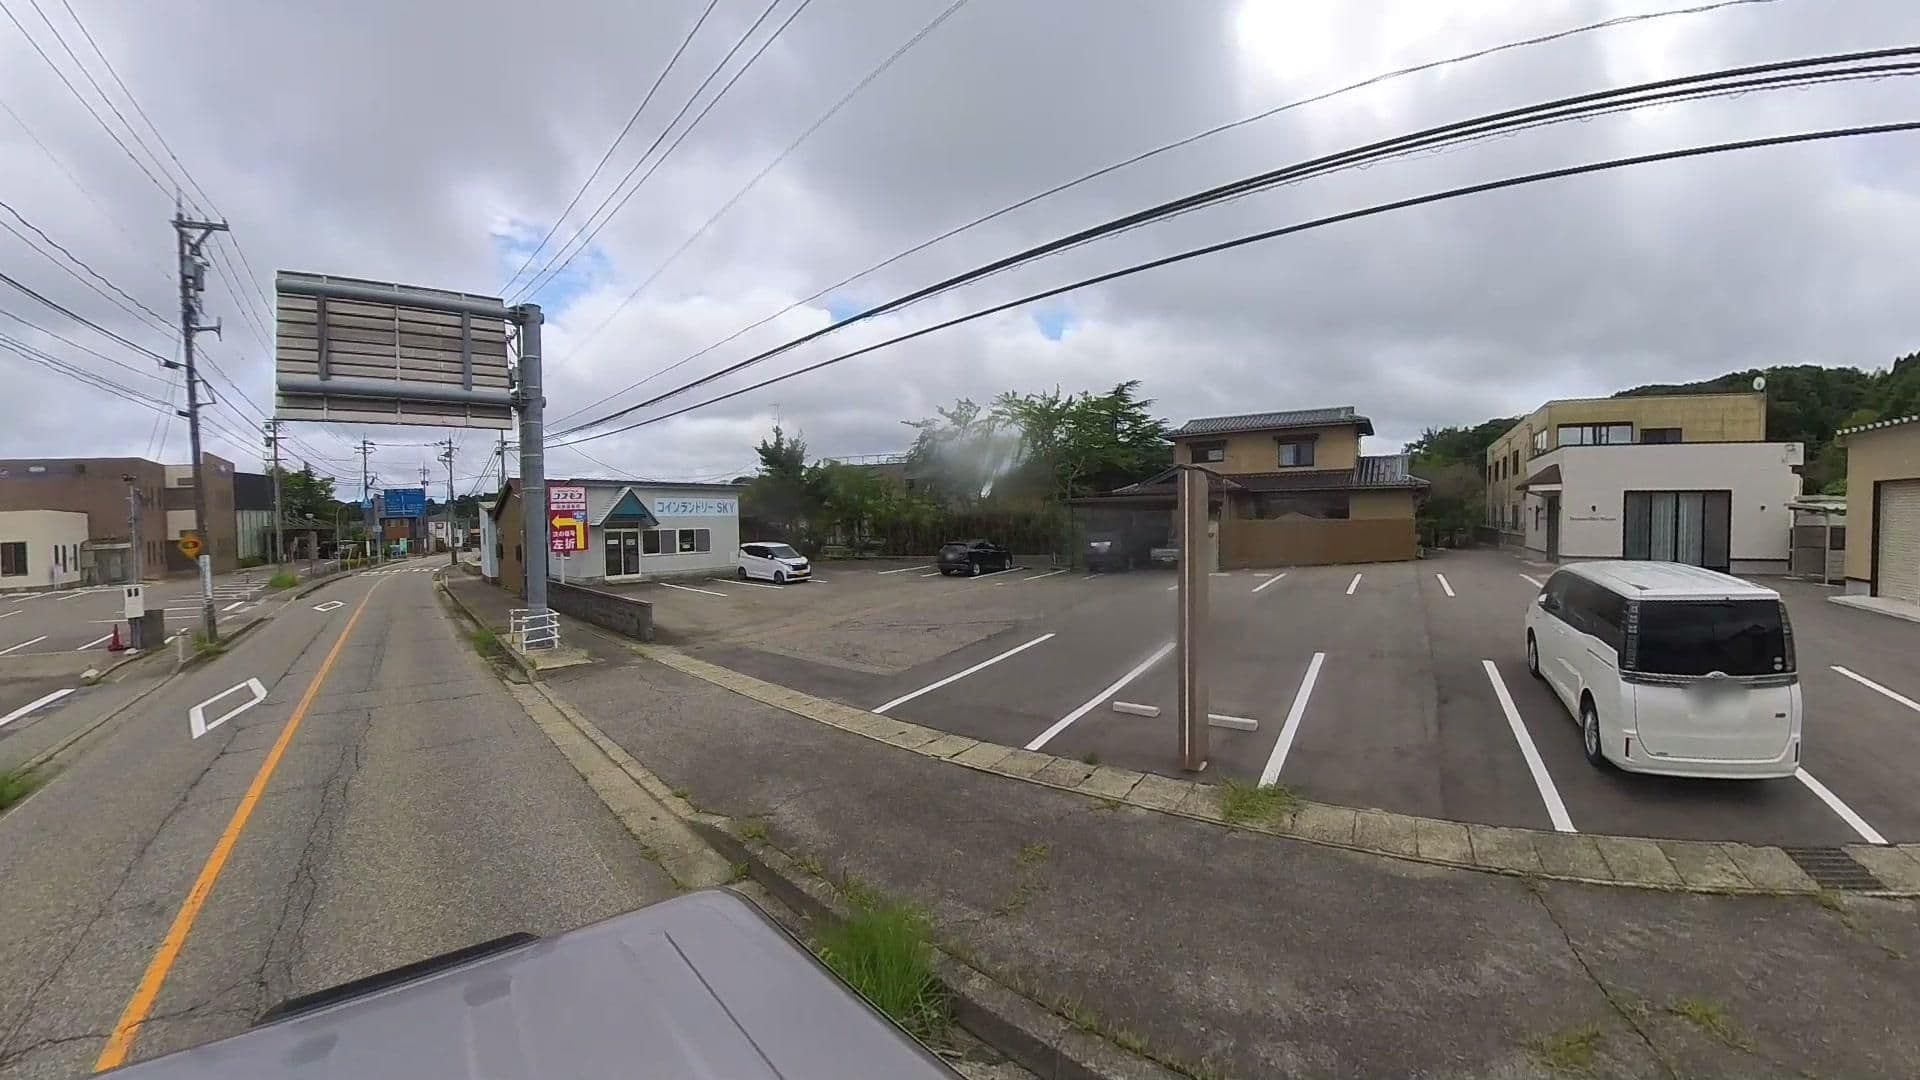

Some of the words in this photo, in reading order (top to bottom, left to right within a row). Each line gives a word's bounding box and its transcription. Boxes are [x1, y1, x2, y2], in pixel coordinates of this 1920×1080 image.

[657, 501, 714, 513] コインランドリー
[716, 502, 736, 513] SKY
[552, 538, 576, 550] 左折
